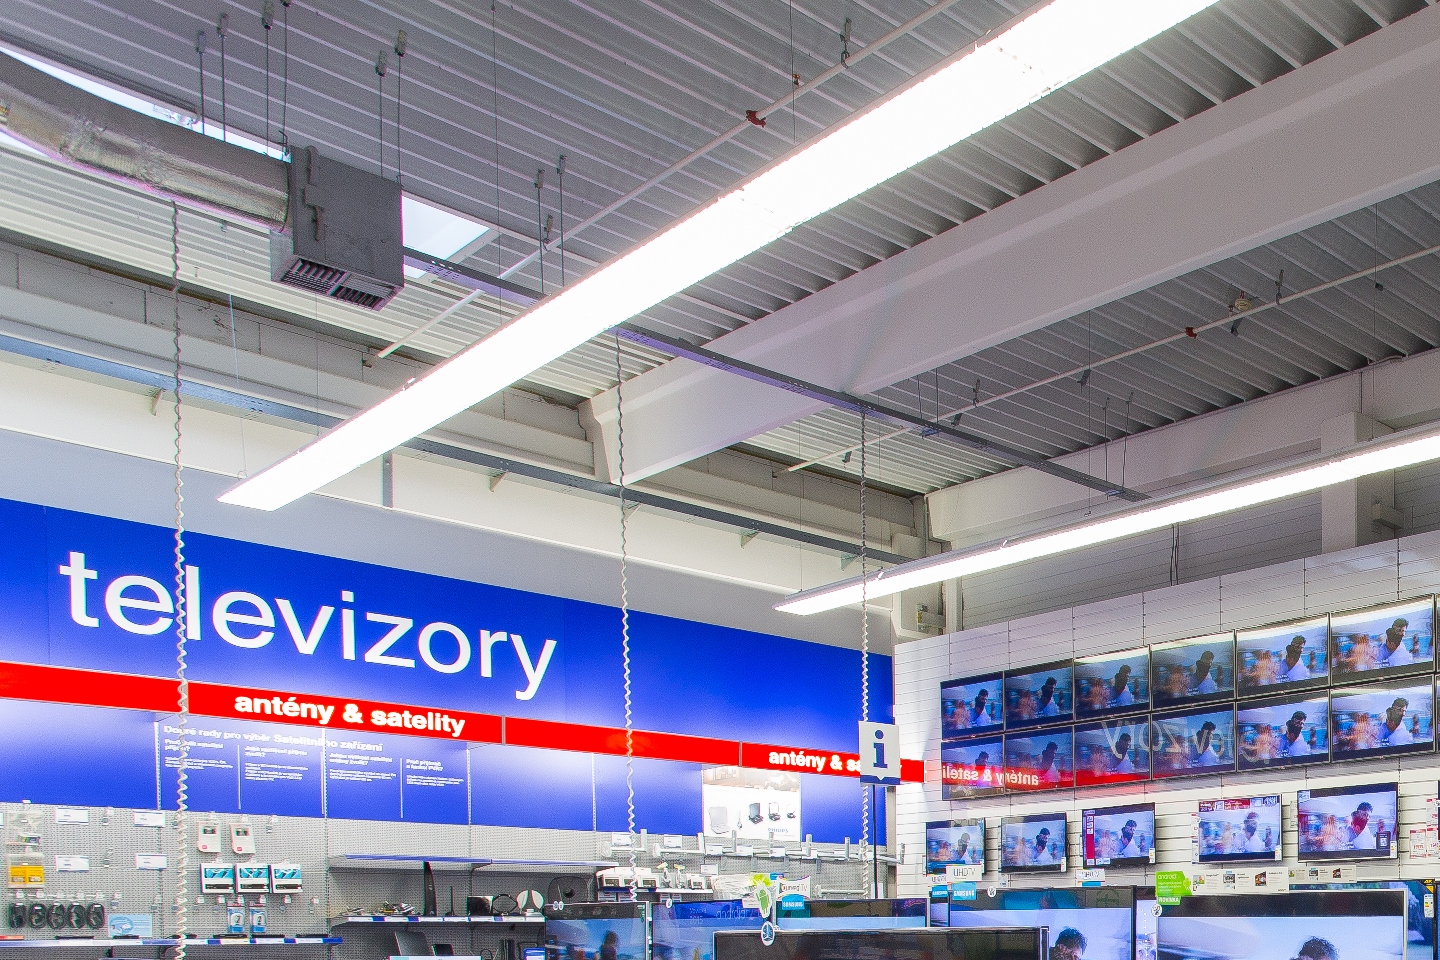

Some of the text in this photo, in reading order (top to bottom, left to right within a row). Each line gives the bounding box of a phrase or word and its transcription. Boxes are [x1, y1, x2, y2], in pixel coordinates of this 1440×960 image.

[59, 551, 557, 701] televizory
[234, 695, 465, 738] antény & satelity
[199, 729, 222, 740] rady
[224, 731, 241, 740] pro
[243, 732, 271, 742] výběr
[339, 739, 383, 752] zařízení
[768, 750, 826, 773] antény
[829, 753, 844, 770] &
